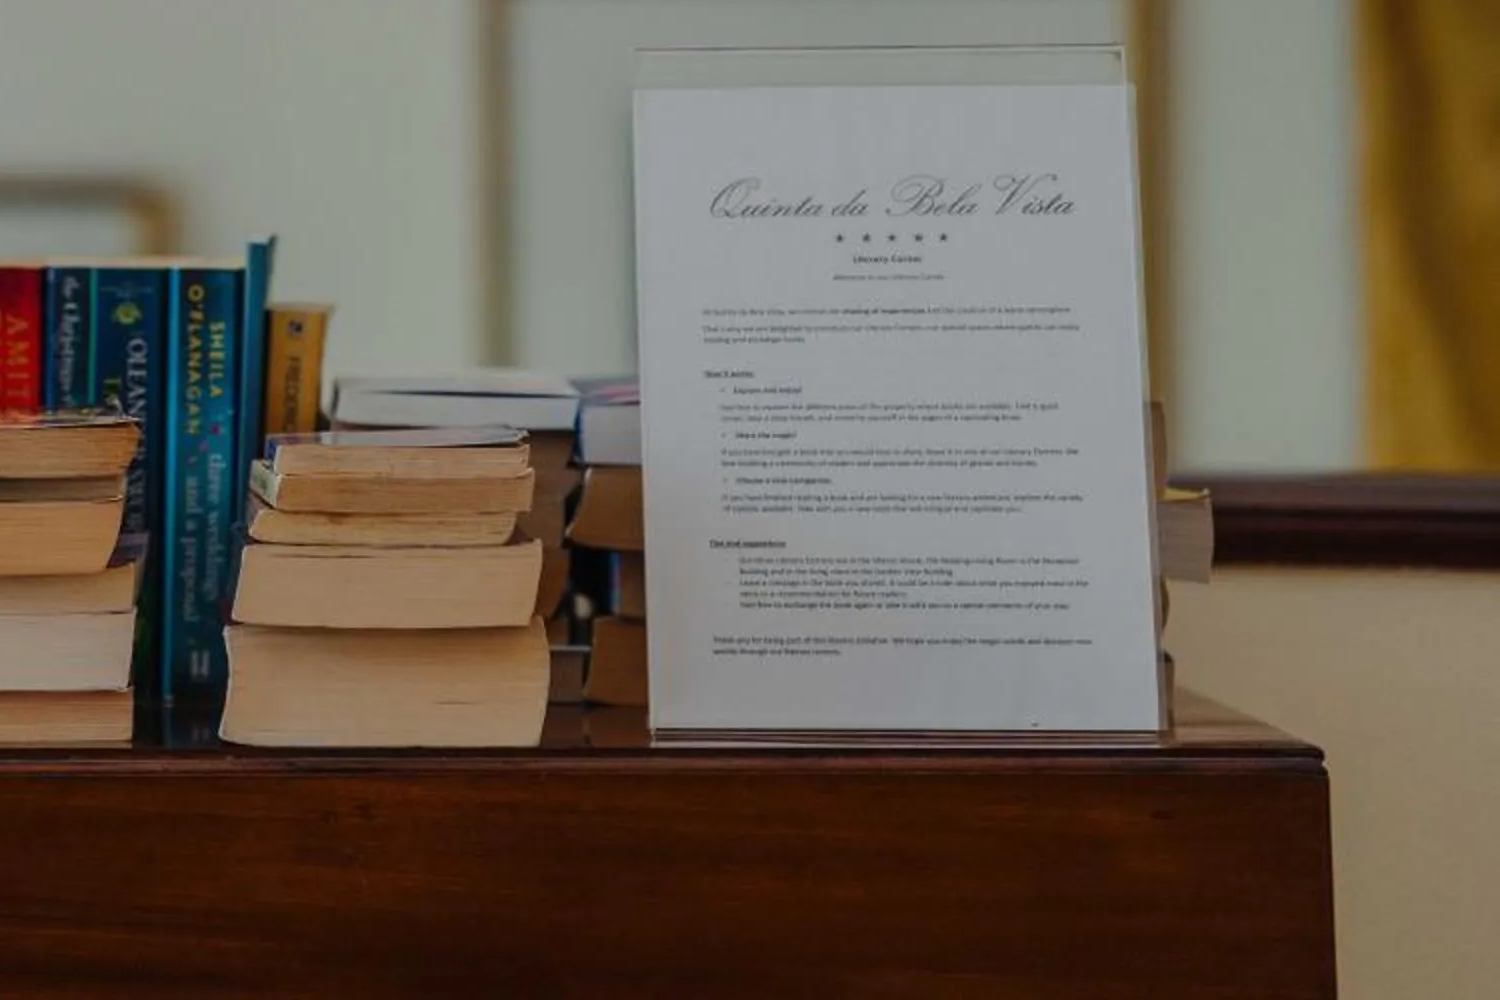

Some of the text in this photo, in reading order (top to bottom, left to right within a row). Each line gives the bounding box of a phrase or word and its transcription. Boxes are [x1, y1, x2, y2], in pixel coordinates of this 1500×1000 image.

[709, 172, 1078, 219] Quinta da Bela Vista
[5, 313, 31, 402] AMIT
[185, 283, 205, 435] O'FLANAGAN
[208, 321, 226, 399] SHEILA
